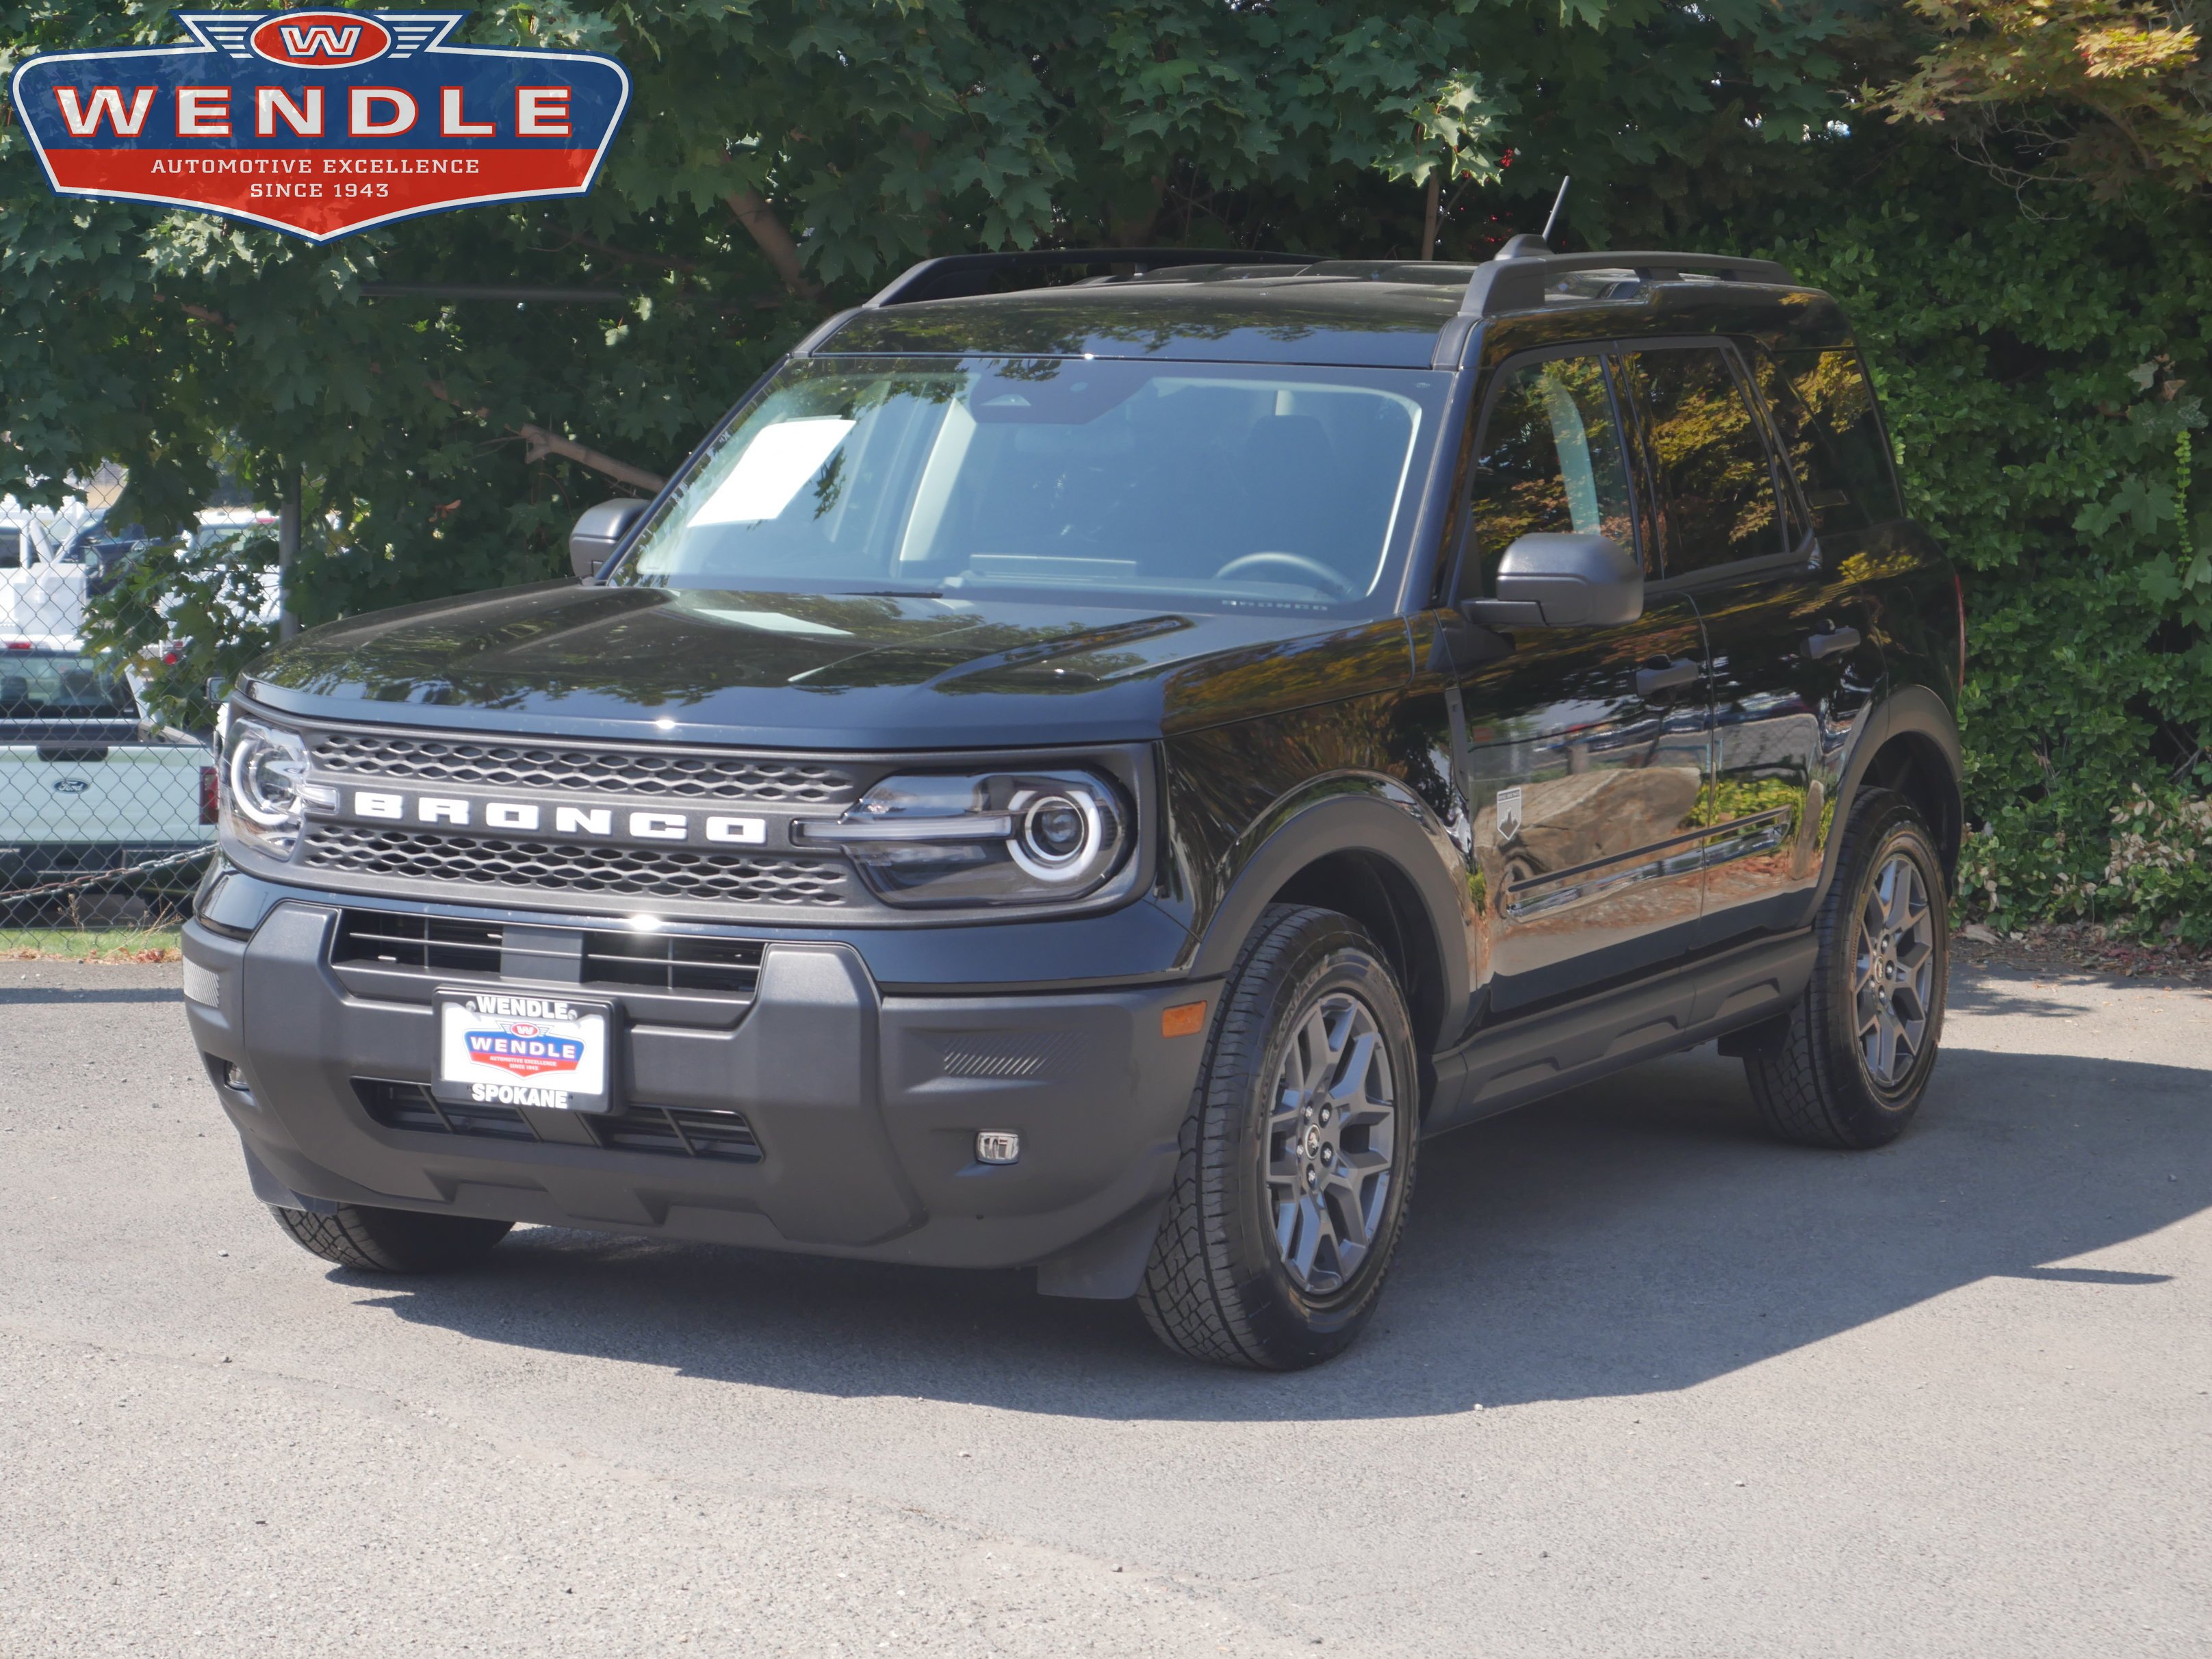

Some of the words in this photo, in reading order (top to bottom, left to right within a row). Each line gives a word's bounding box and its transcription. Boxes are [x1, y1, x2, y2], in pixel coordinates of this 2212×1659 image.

[57, 781, 84, 791] Ford
[355, 791, 766, 844] BRONCO
[476, 995, 568, 1019] WENDLE
[517, 1026, 533, 1036] W
[470, 1036, 576, 1059] WENDLE
[472, 1083, 568, 1109] SPOKANE
